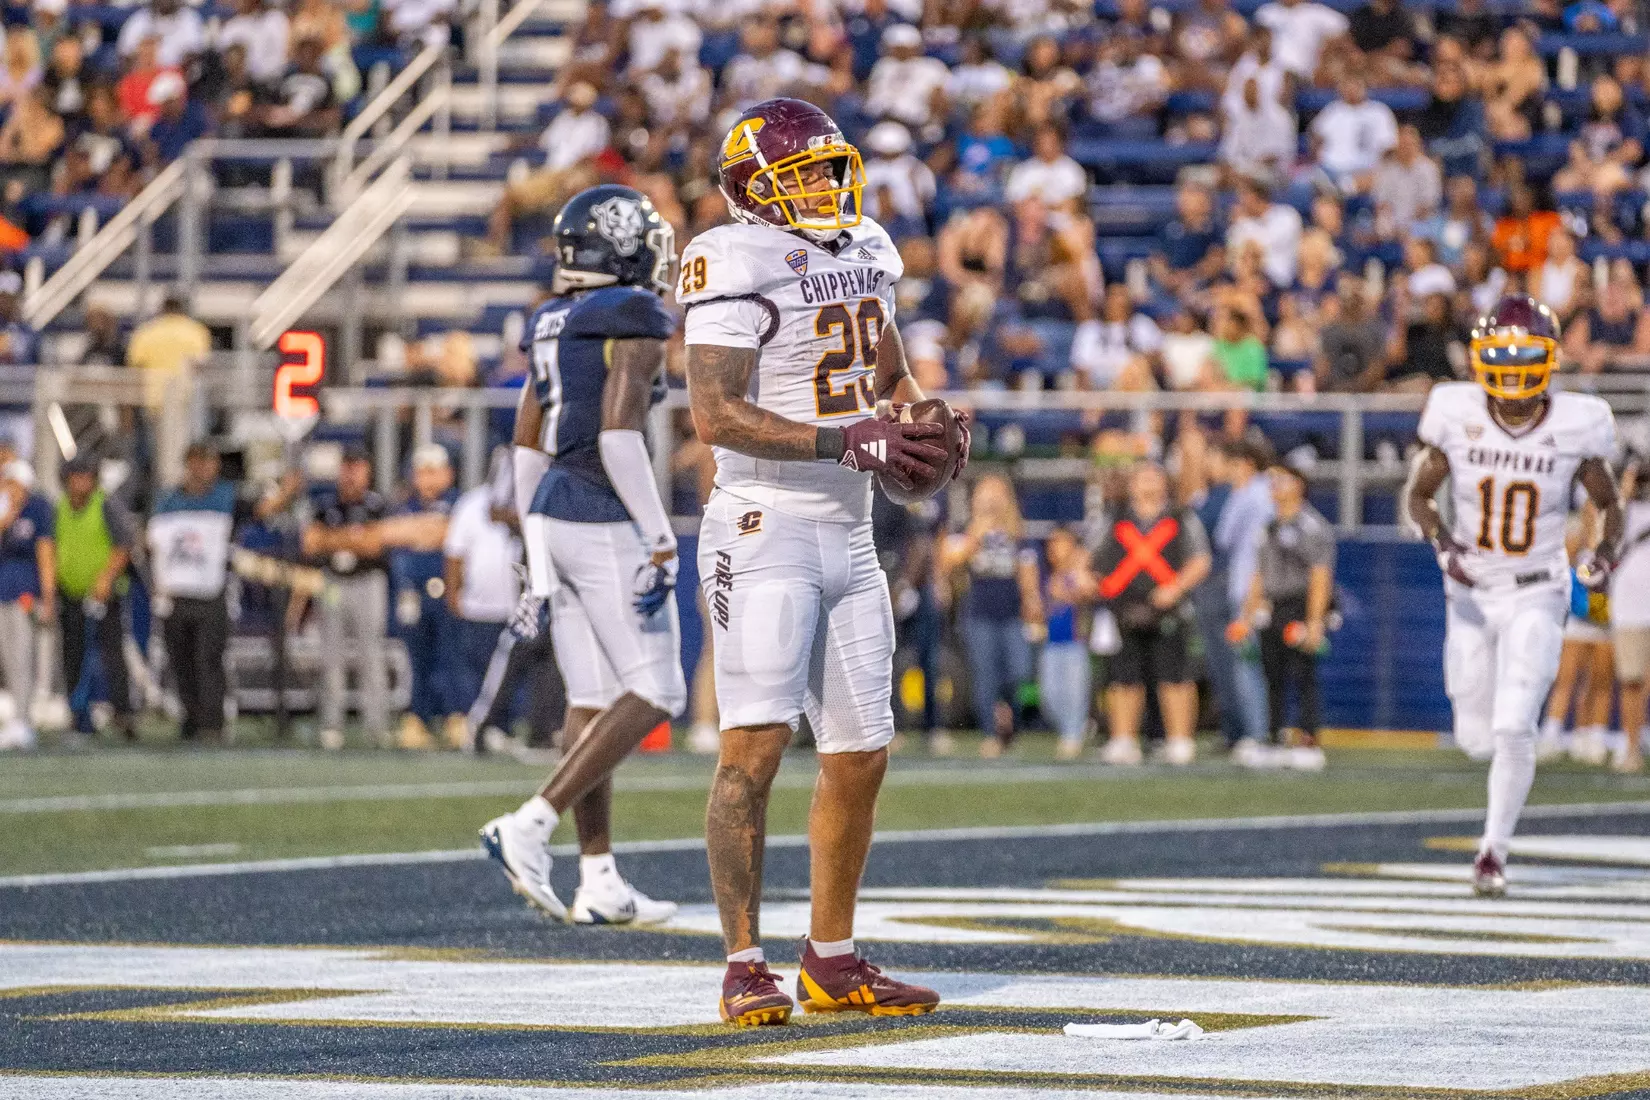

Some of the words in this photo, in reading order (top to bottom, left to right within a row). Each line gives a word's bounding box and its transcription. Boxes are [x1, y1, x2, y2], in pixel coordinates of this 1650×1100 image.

[681, 255, 708, 296] 29
[789, 255, 808, 268] MAC
[800, 267, 885, 304] CHIPPEWAS
[273, 330, 326, 418] 2
[813, 297, 885, 418] 29
[1467, 447, 1555, 474] CHIPPEWAS
[1477, 475, 1541, 557] 10
[714, 550, 734, 591] FIRE
[713, 590, 730, 632] UP!
